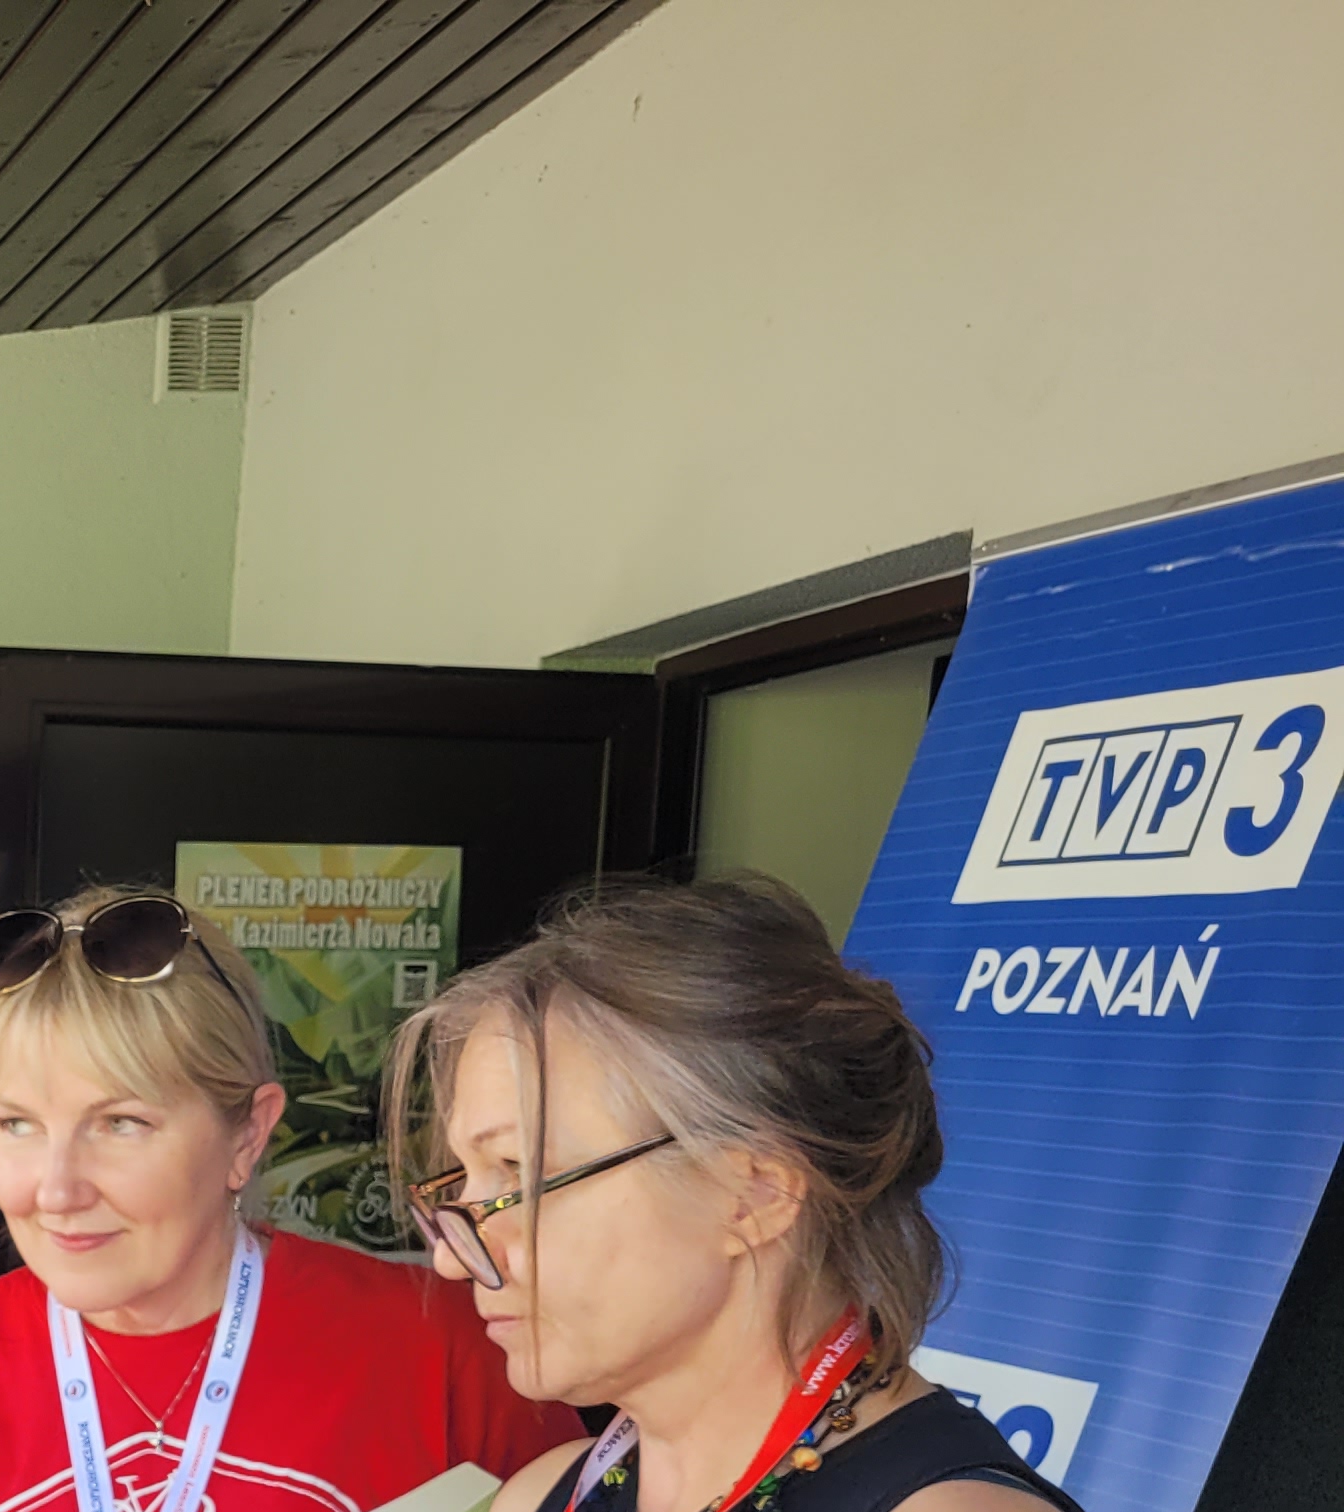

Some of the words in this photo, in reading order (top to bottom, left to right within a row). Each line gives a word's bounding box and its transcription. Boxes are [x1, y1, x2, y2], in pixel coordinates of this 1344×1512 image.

[1223, 703, 1327, 857] 3
[354, 915, 441, 951] Nowaka
[954, 924, 1221, 1020] POZNAŃ
